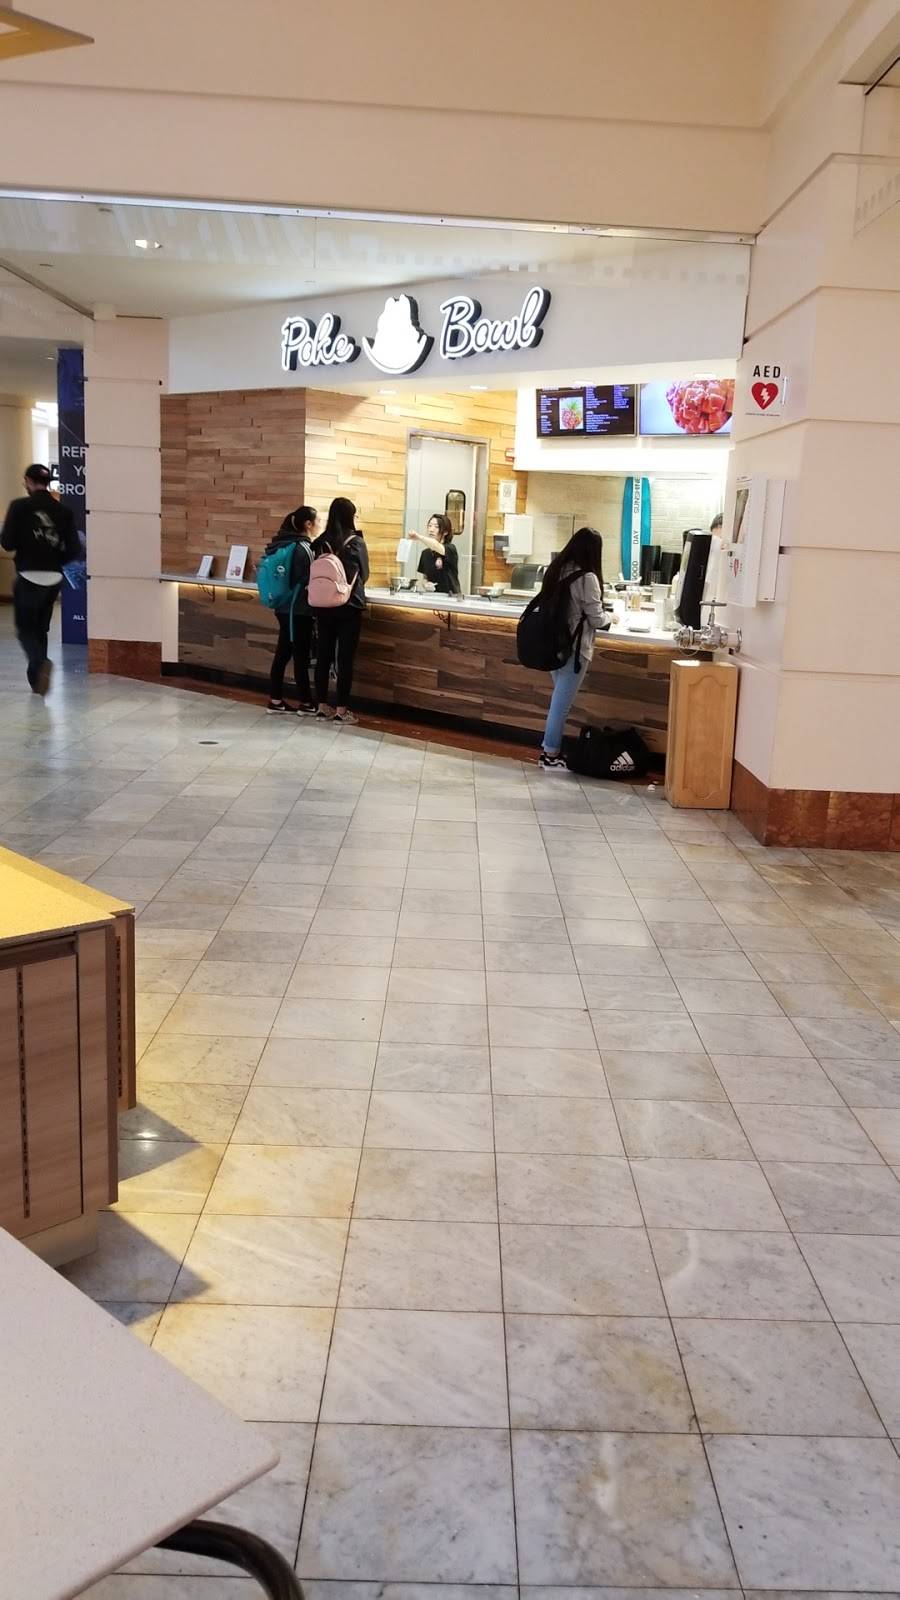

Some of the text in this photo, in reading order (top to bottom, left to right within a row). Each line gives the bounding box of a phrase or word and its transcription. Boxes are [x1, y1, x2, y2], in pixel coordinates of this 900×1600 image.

[281, 286, 550, 371] Poke Bowl
[753, 365, 781, 378] AED
